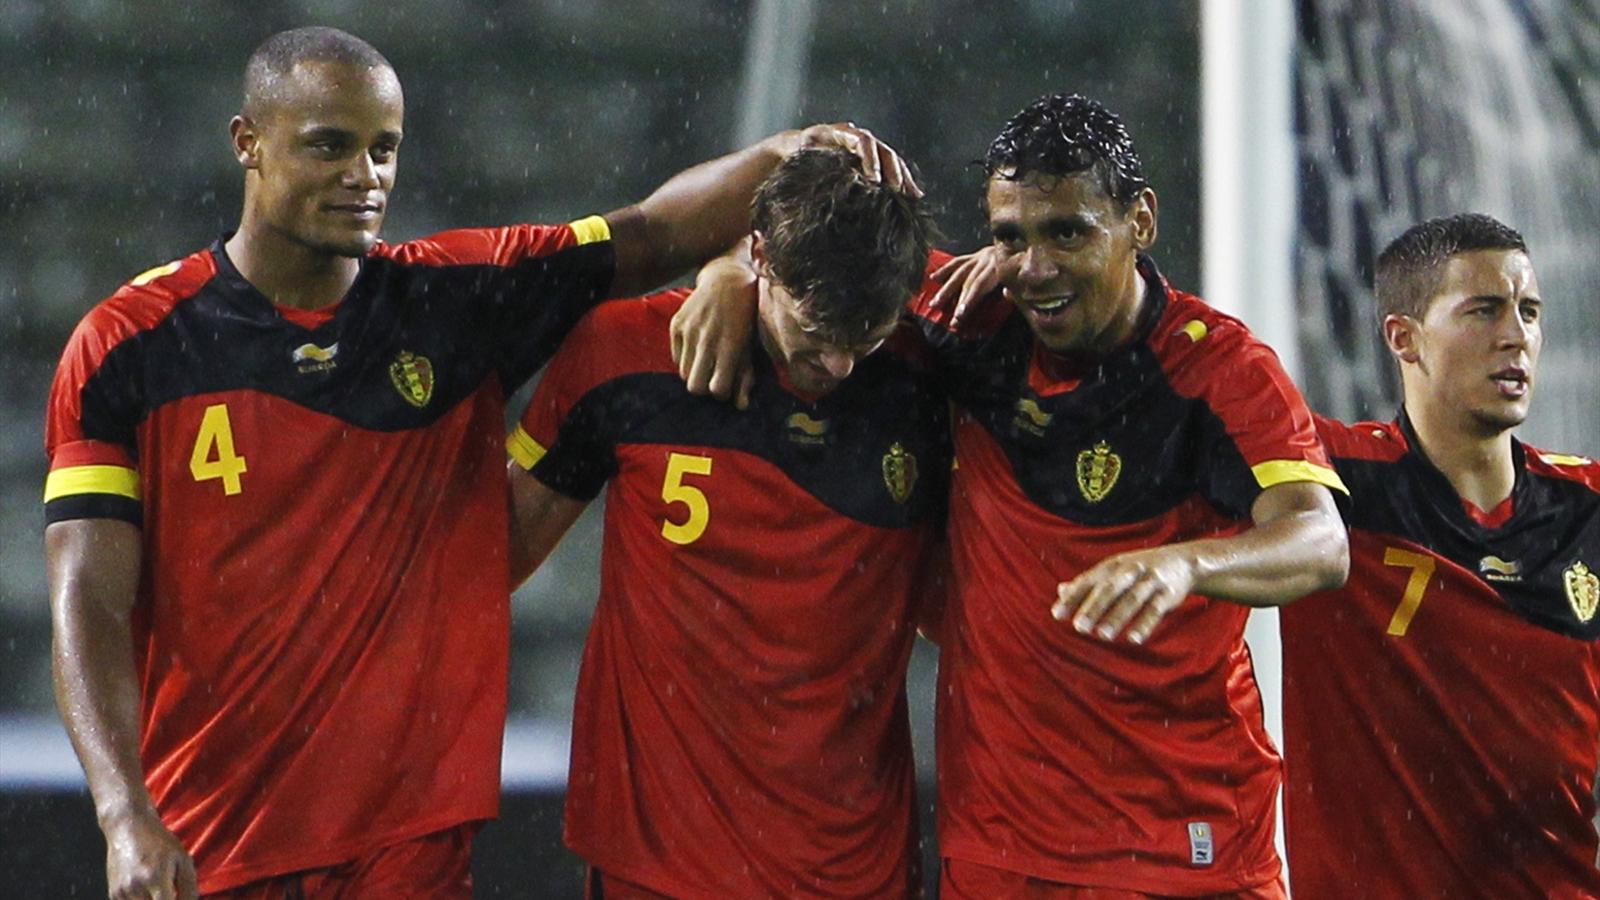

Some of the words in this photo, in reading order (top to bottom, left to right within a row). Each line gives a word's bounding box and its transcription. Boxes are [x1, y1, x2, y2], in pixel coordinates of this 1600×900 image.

[189, 403, 247, 496] 4
[661, 452, 712, 545] 5
[1383, 547, 1436, 636] 7
